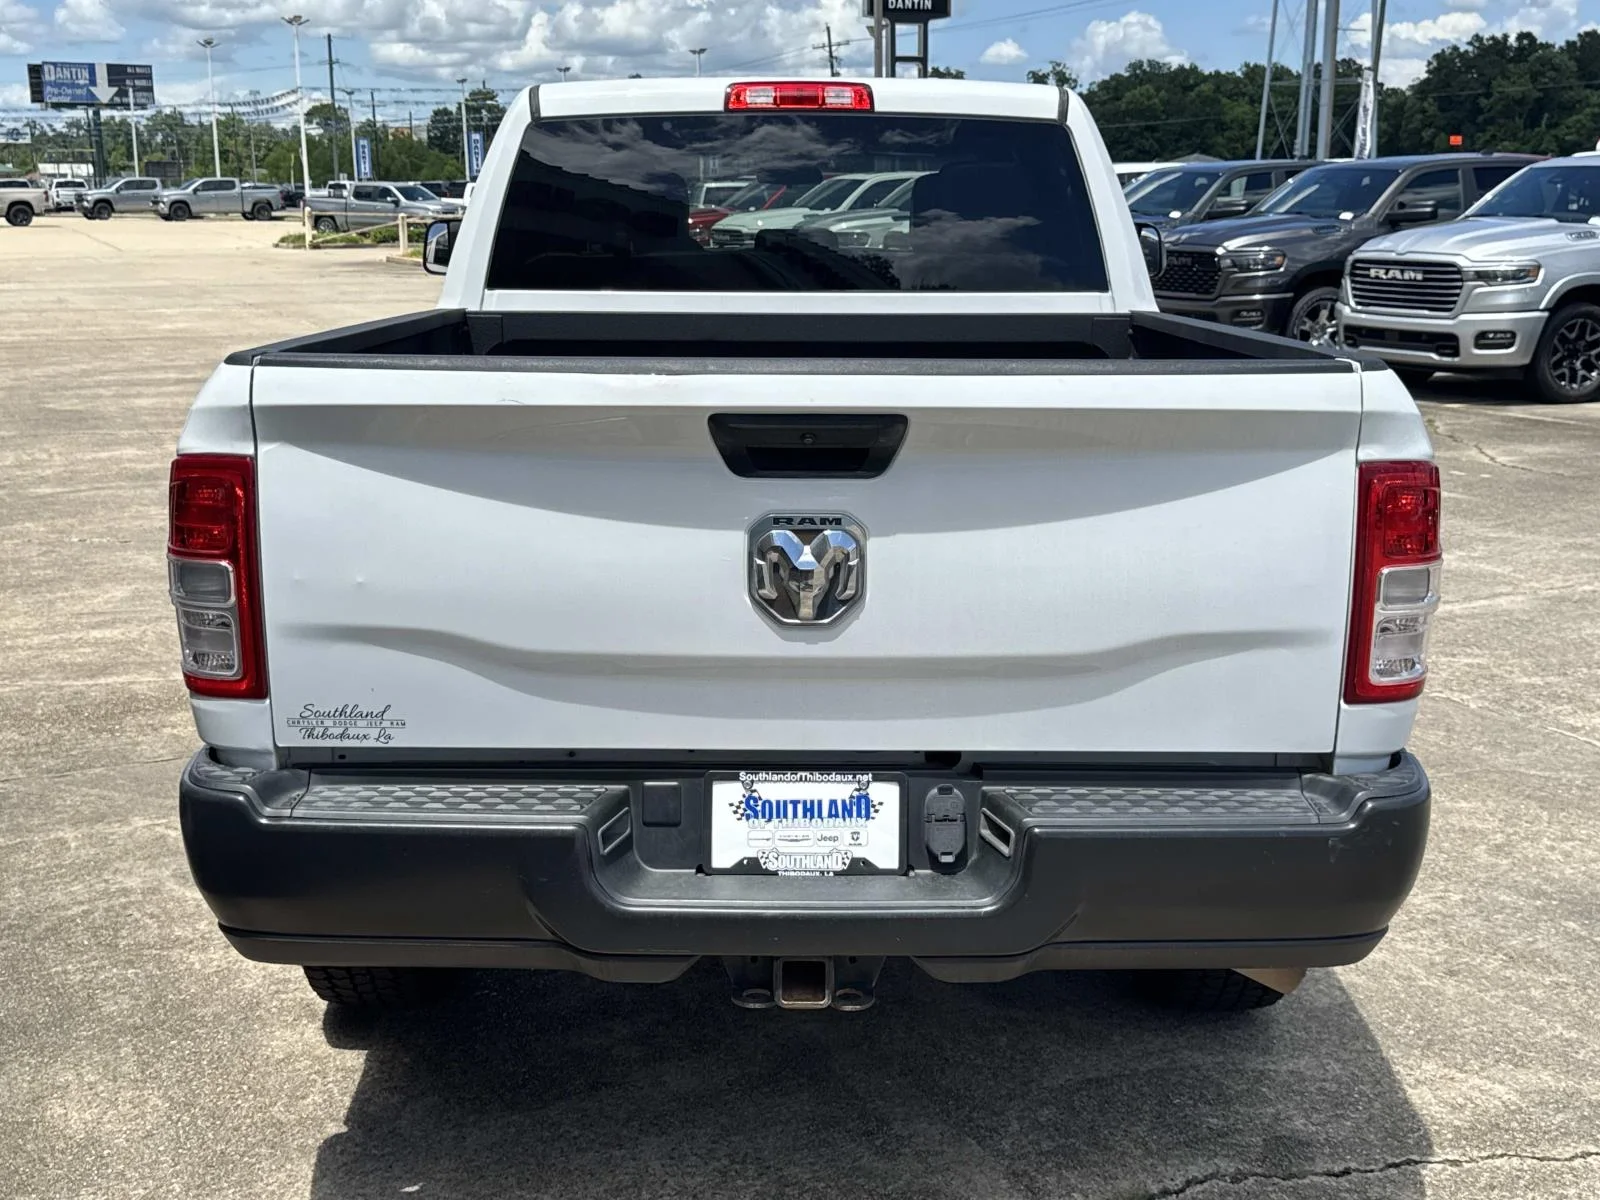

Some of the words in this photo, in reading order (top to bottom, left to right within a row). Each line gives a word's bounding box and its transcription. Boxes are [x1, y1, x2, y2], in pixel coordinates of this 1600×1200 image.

[888, 0, 932, 10] DANTIN
[44, 64, 90, 81] DANTIN
[1369, 267, 1424, 281] RAM
[772, 517, 843, 526] RAM
[299, 703, 392, 721] Southland
[366, 720, 384, 728] JEEP
[298, 727, 371, 742] Thibodaux
[373, 727, 395, 745] La
[739, 771, 873, 782] SouthlandofThibodaux.net
[744, 794, 872, 822] SOUTHLAND
[817, 833, 839, 843] Jeep
[767, 851, 843, 871] SOUTHLAND
